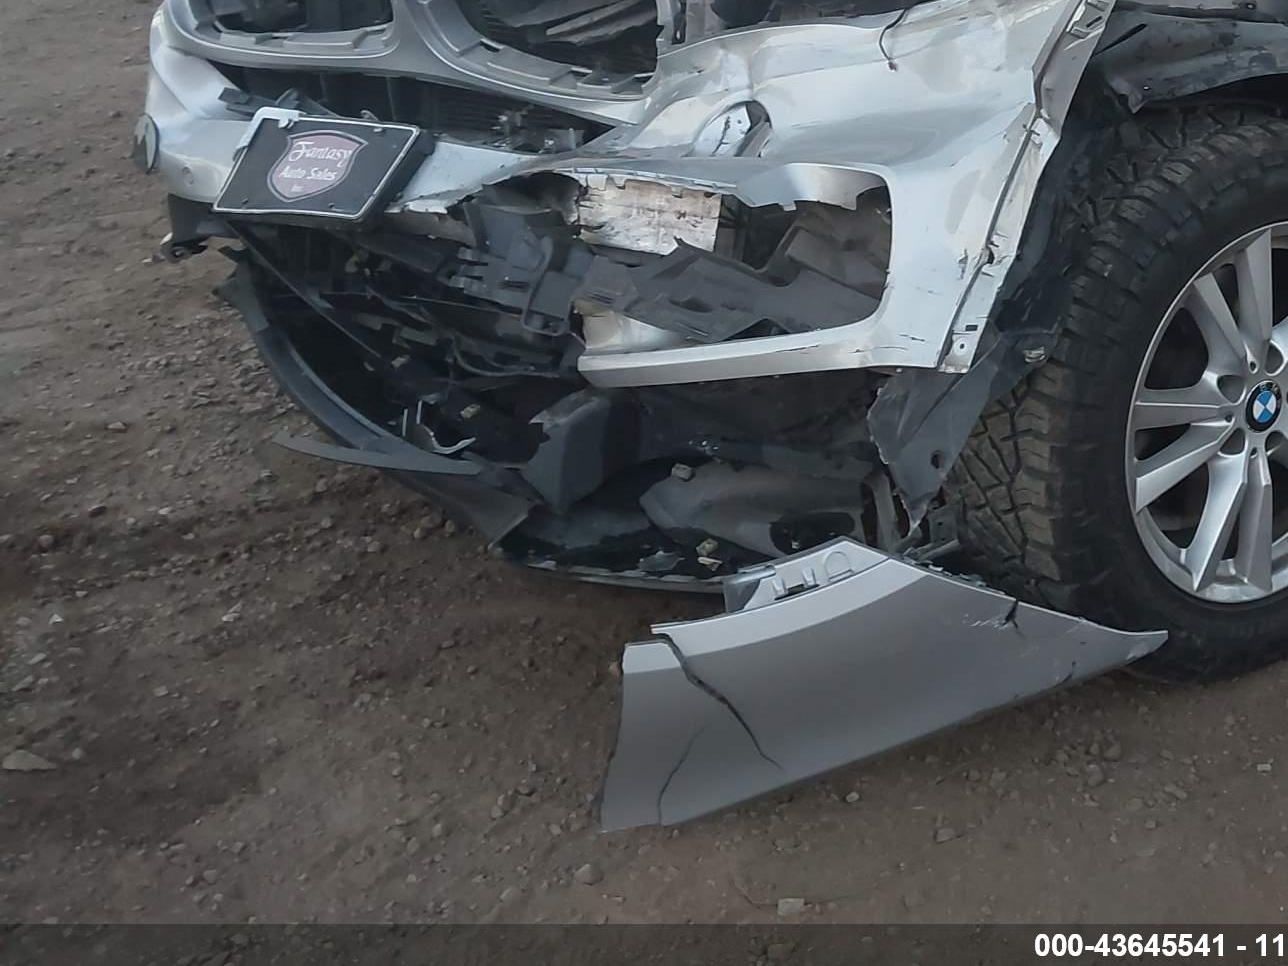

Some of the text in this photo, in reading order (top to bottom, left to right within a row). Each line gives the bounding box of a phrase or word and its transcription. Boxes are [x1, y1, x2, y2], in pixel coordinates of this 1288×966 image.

[288, 140, 353, 168] Fantasy
[279, 166, 338, 181] Auto Sales
